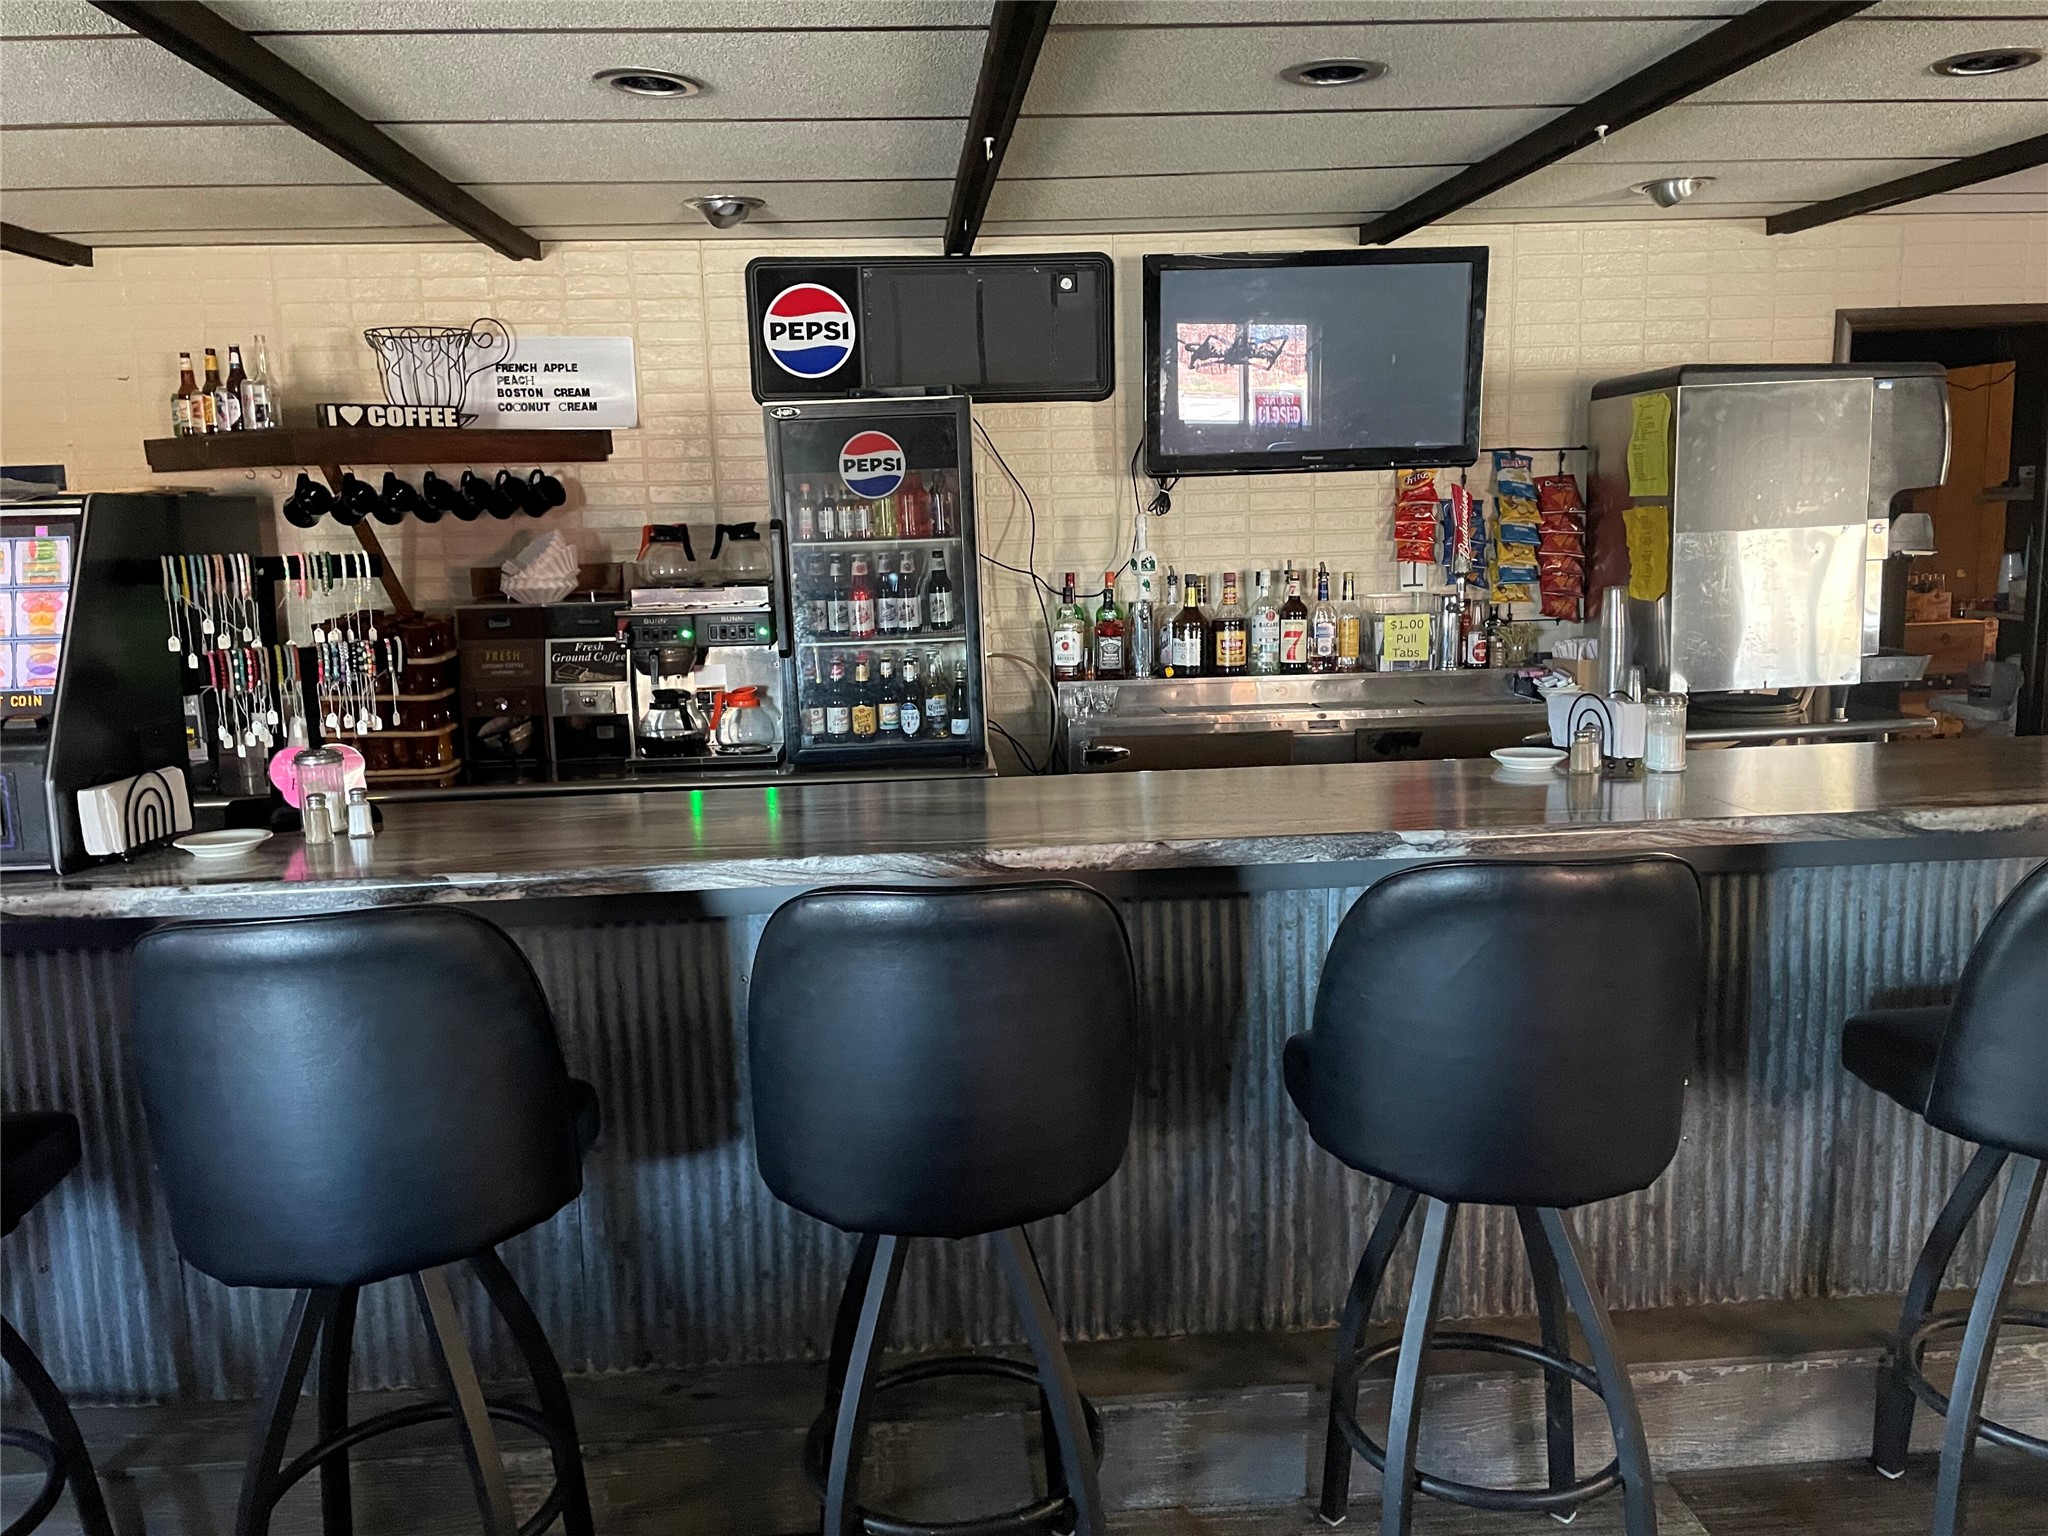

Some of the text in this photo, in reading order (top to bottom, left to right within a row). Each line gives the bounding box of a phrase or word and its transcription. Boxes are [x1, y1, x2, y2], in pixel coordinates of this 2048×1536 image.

[770, 321, 849, 341] PEPSI
[495, 363, 579, 373] FRENCH APPLE
[497, 375, 535, 385] PEACH
[497, 388, 591, 398] BOSTON CREAM
[497, 402, 598, 412] COCONUT CREAM
[327, 405, 460, 427] I COFFEE
[843, 457, 902, 473] PEPSI
[1458, 489, 1470, 559] Budweiser
[1390, 619, 1424, 630] $1.00
[1396, 634, 1417, 643] Pull
[574, 642, 604, 652] Fresh
[1283, 630, 1304, 660] 7
[486, 651, 520, 661] FRESH
[552, 650, 627, 663] Ground Coffee
[1392, 648, 1420, 658] Tabs
[10, 695, 42, 706] COIN
